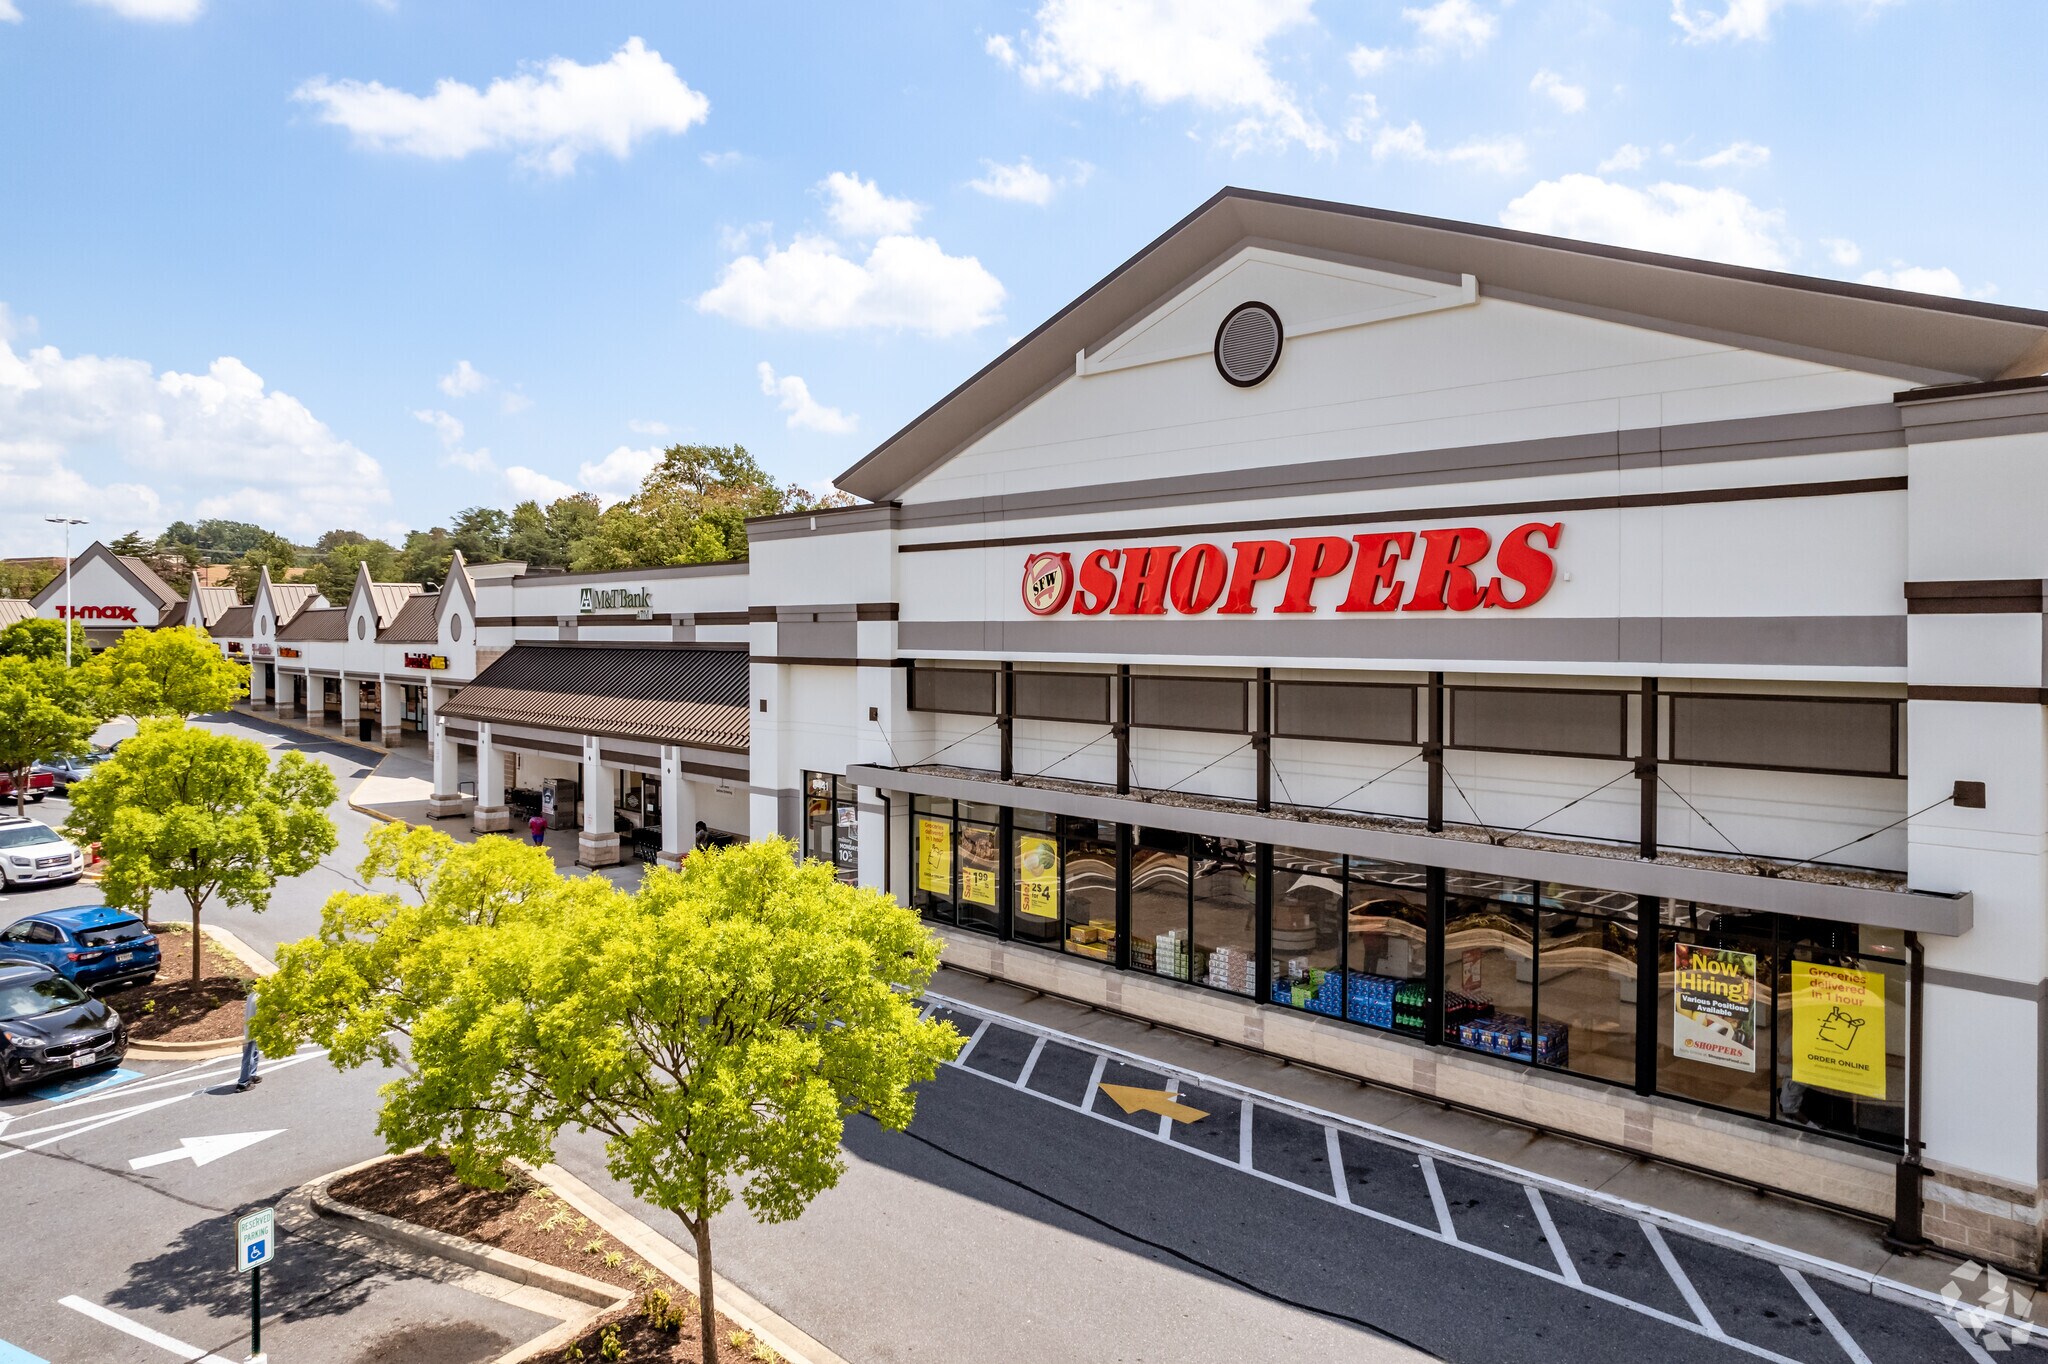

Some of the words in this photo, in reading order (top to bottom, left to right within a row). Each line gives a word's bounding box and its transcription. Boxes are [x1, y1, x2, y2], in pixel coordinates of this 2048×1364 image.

[1072, 522, 1564, 615] SHOPPERS
[1032, 570, 1058, 597] SFW
[595, 589, 619, 610] M&T
[620, 586, 653, 608] Bank
[1692, 953, 1739, 978] Now
[1808, 967, 1867, 985] Groceries
[1681, 971, 1749, 1003] Hiring!
[1809, 978, 1866, 996] delivered
[1682, 994, 1711, 1006] Various
[1712, 1000, 1749, 1013] Positions
[1811, 989, 1822, 999] in
[1835, 993, 1865, 1007] hour
[1697, 1004, 1733, 1017] Available
[1694, 1041, 1743, 1058] SHOPPERS
[1807, 1053, 1836, 1065] ORDER
[1838, 1059, 1870, 1072] ONLINE
[241, 1213, 271, 1231] RESERVED
[243, 1226, 269, 1242] PARKING
